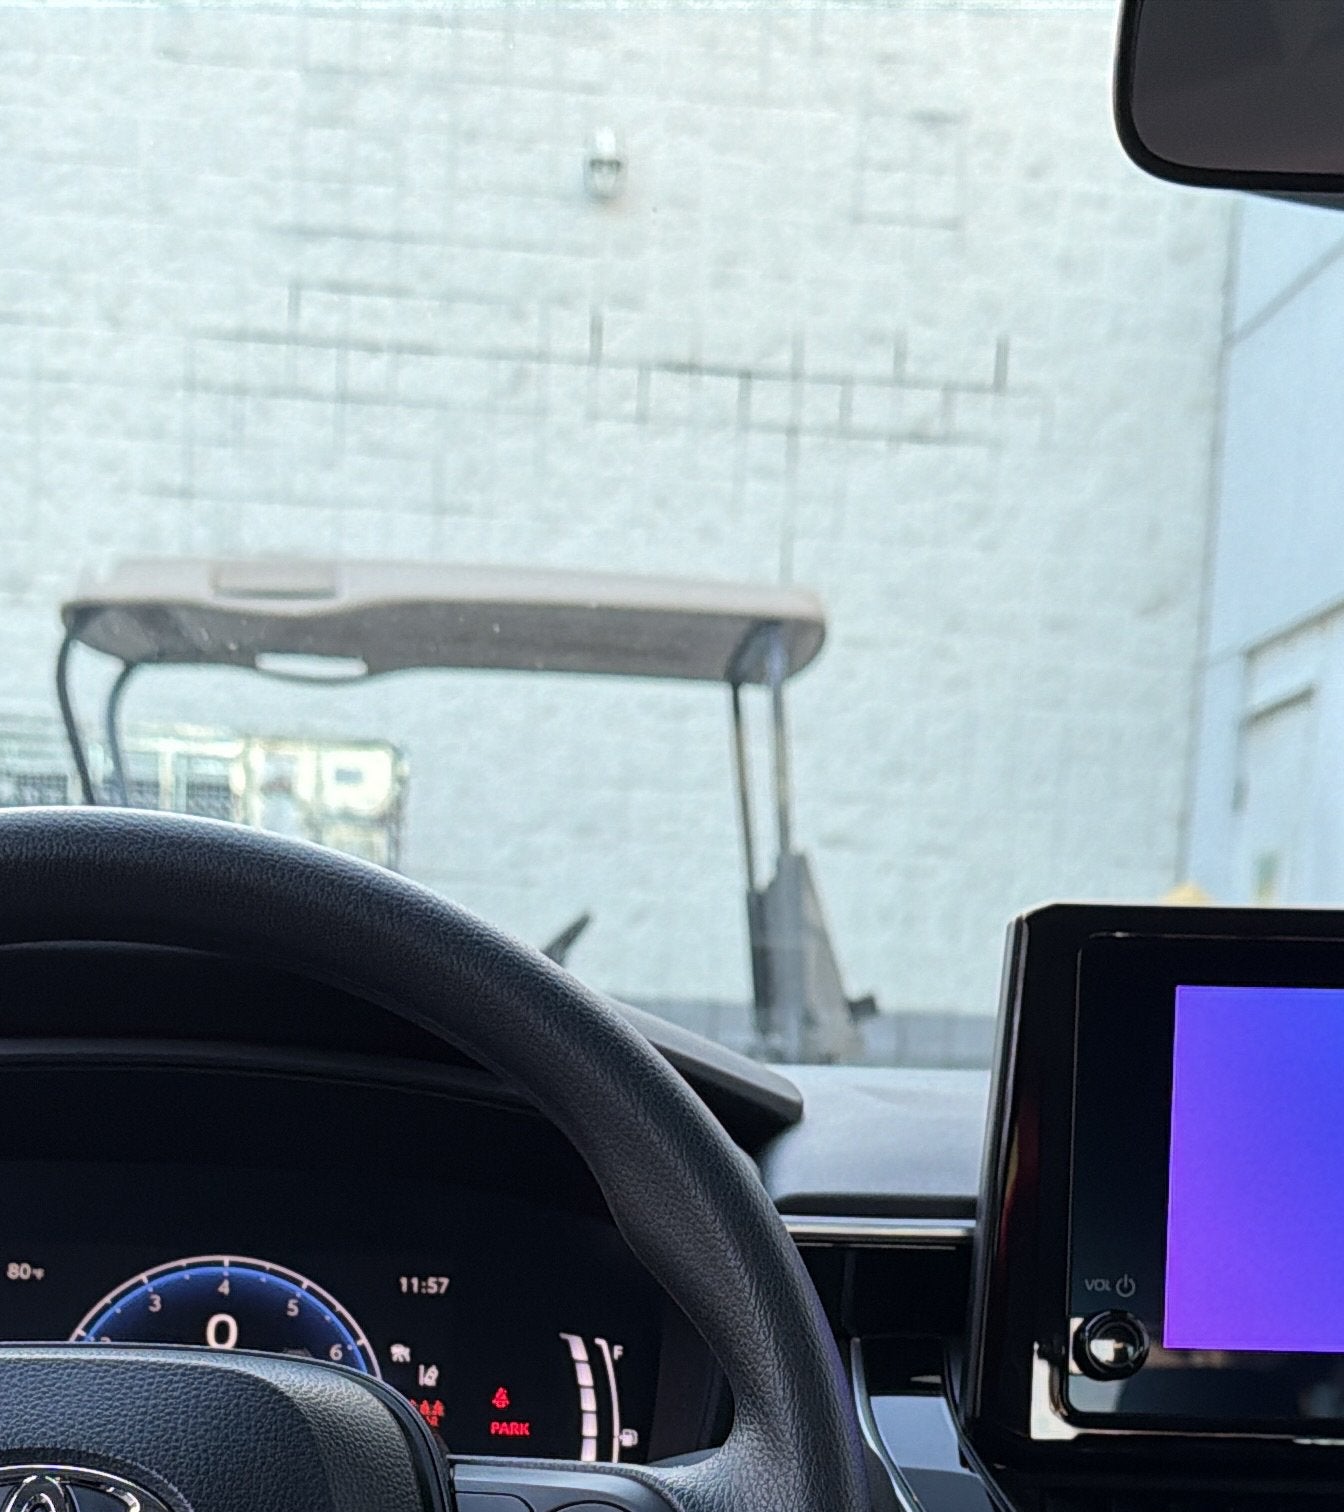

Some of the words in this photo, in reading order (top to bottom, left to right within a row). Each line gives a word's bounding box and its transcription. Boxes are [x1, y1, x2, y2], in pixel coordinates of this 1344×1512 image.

[217, 1279, 230, 1296] 4
[399, 1276, 450, 1294] 11:57
[1084, 1278, 1111, 1292] VOL
[149, 1294, 161, 1312] 3
[286, 1299, 299, 1317] 5
[206, 1313, 238, 1349] 0
[330, 1344, 343, 1361] 6
[613, 1345, 623, 1360] F
[490, 1421, 530, 1436] PARK
